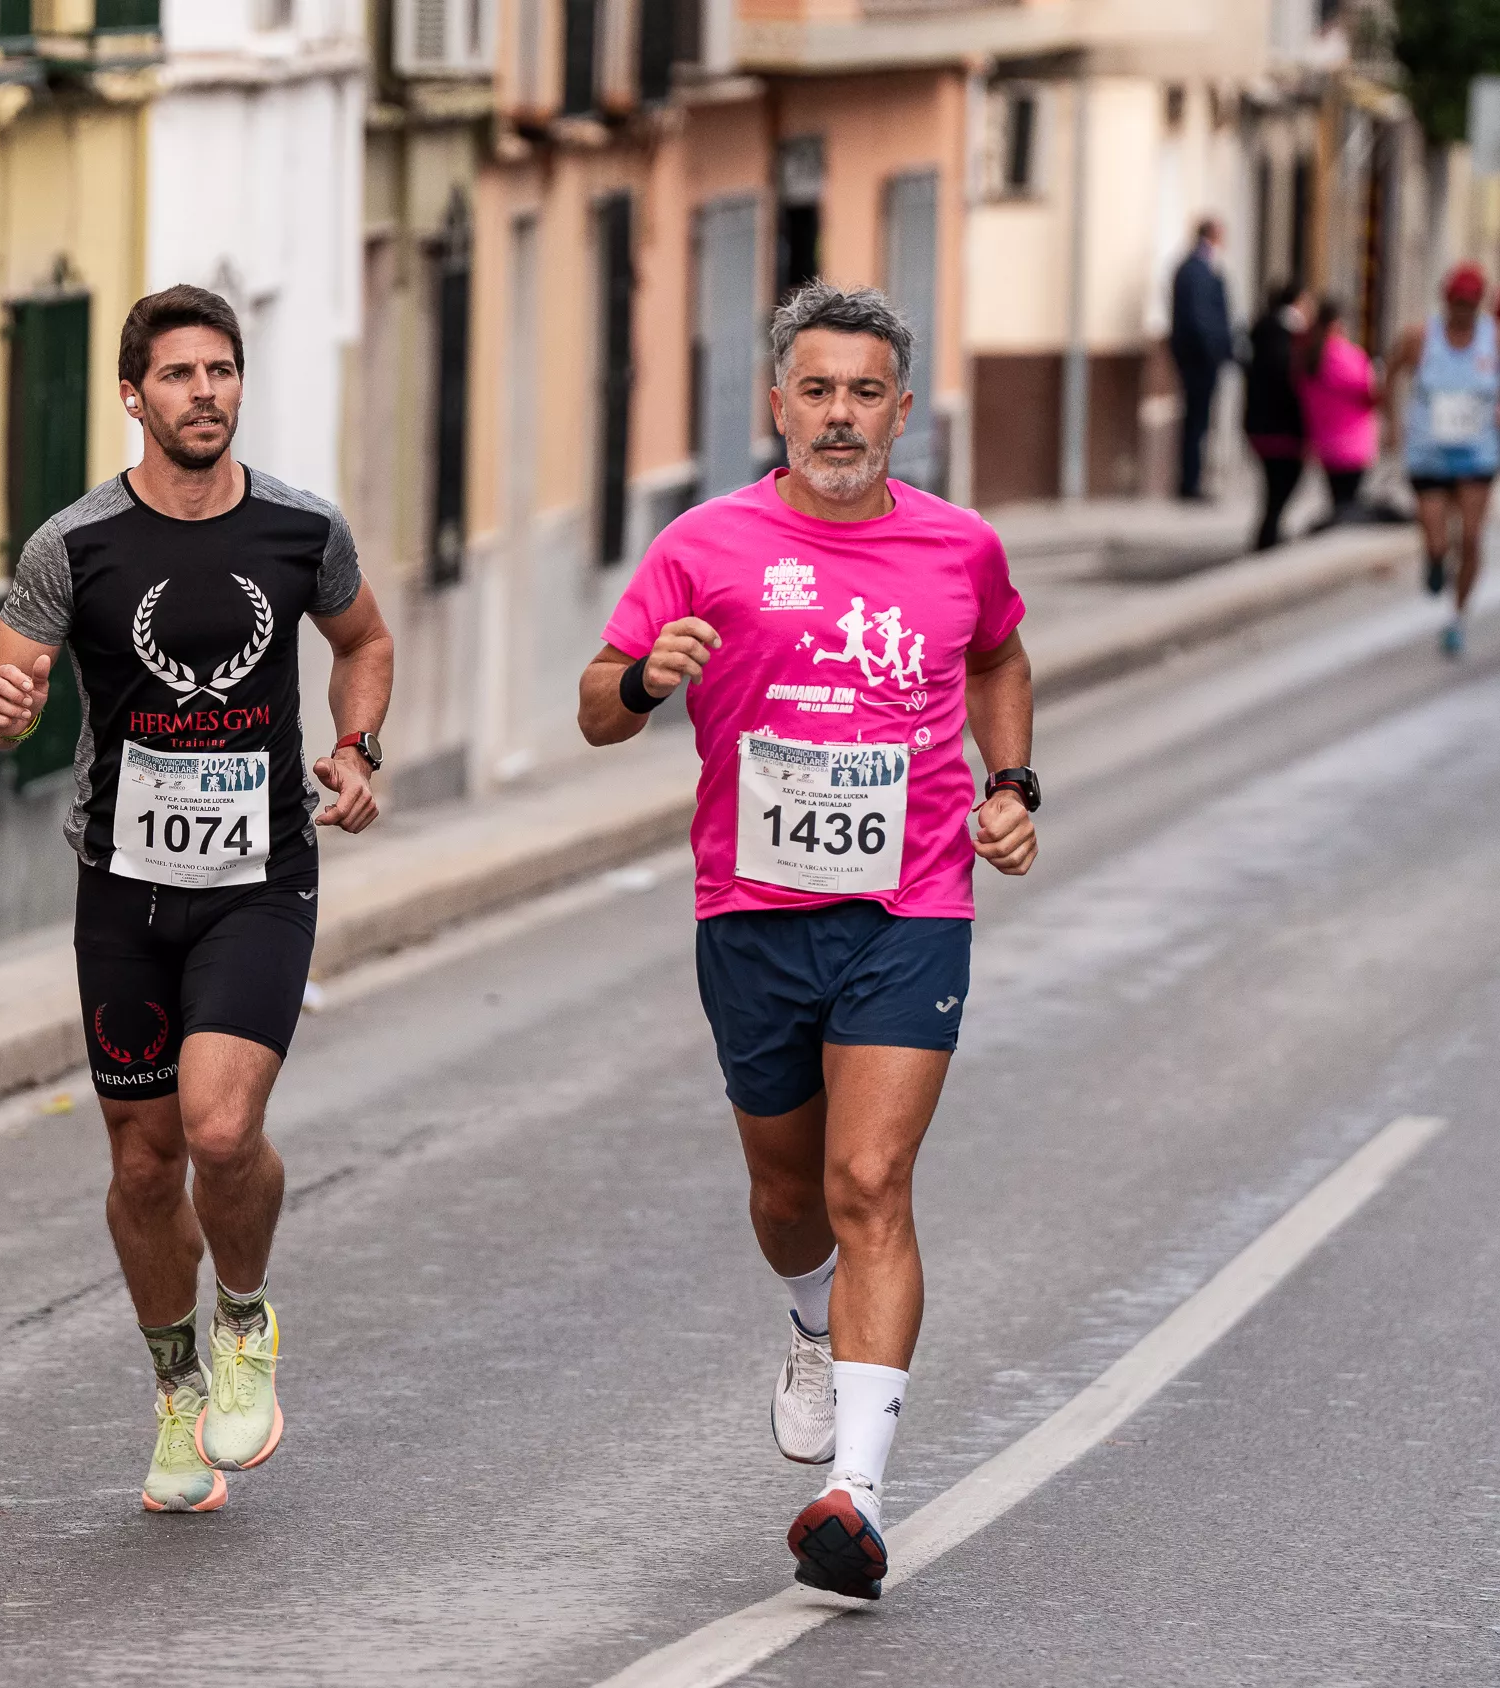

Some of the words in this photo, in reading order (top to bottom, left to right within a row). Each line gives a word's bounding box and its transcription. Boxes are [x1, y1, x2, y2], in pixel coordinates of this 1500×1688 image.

[779, 558, 797, 566] XXV
[764, 565, 814, 578] CARRERA
[763, 577, 816, 585] POPULAR
[762, 591, 818, 601] LUCENA
[766, 684, 831, 702] SUMANDO
[832, 687, 856, 704] KM
[797, 702, 812, 712] POR
[811, 703, 821, 712] LA
[821, 704, 854, 714] IGUALDAD
[129, 711, 219, 733] HERMES
[223, 704, 270, 730] GYM
[170, 738, 226, 748] Training
[750, 740, 777, 751] CIRCUITO
[779, 746, 819, 758] PROVINCIAL
[128, 755, 156, 770] CARRERAS
[159, 765, 199, 774] POPULARES
[152, 758, 188, 767] PROVINCIAL
[749, 747, 784, 760] CARRERAS
[786, 755, 829, 767] POPULARES
[830, 750, 875, 767] 2024
[201, 758, 238, 774] 2024
[138, 810, 252, 856] 1074
[763, 805, 886, 855] 1436
[145, 858, 167, 867] DANIEL
[777, 859, 797, 867] JORGE
[800, 864, 827, 872] VARGAS
[96, 1070, 154, 1085] HERMES
